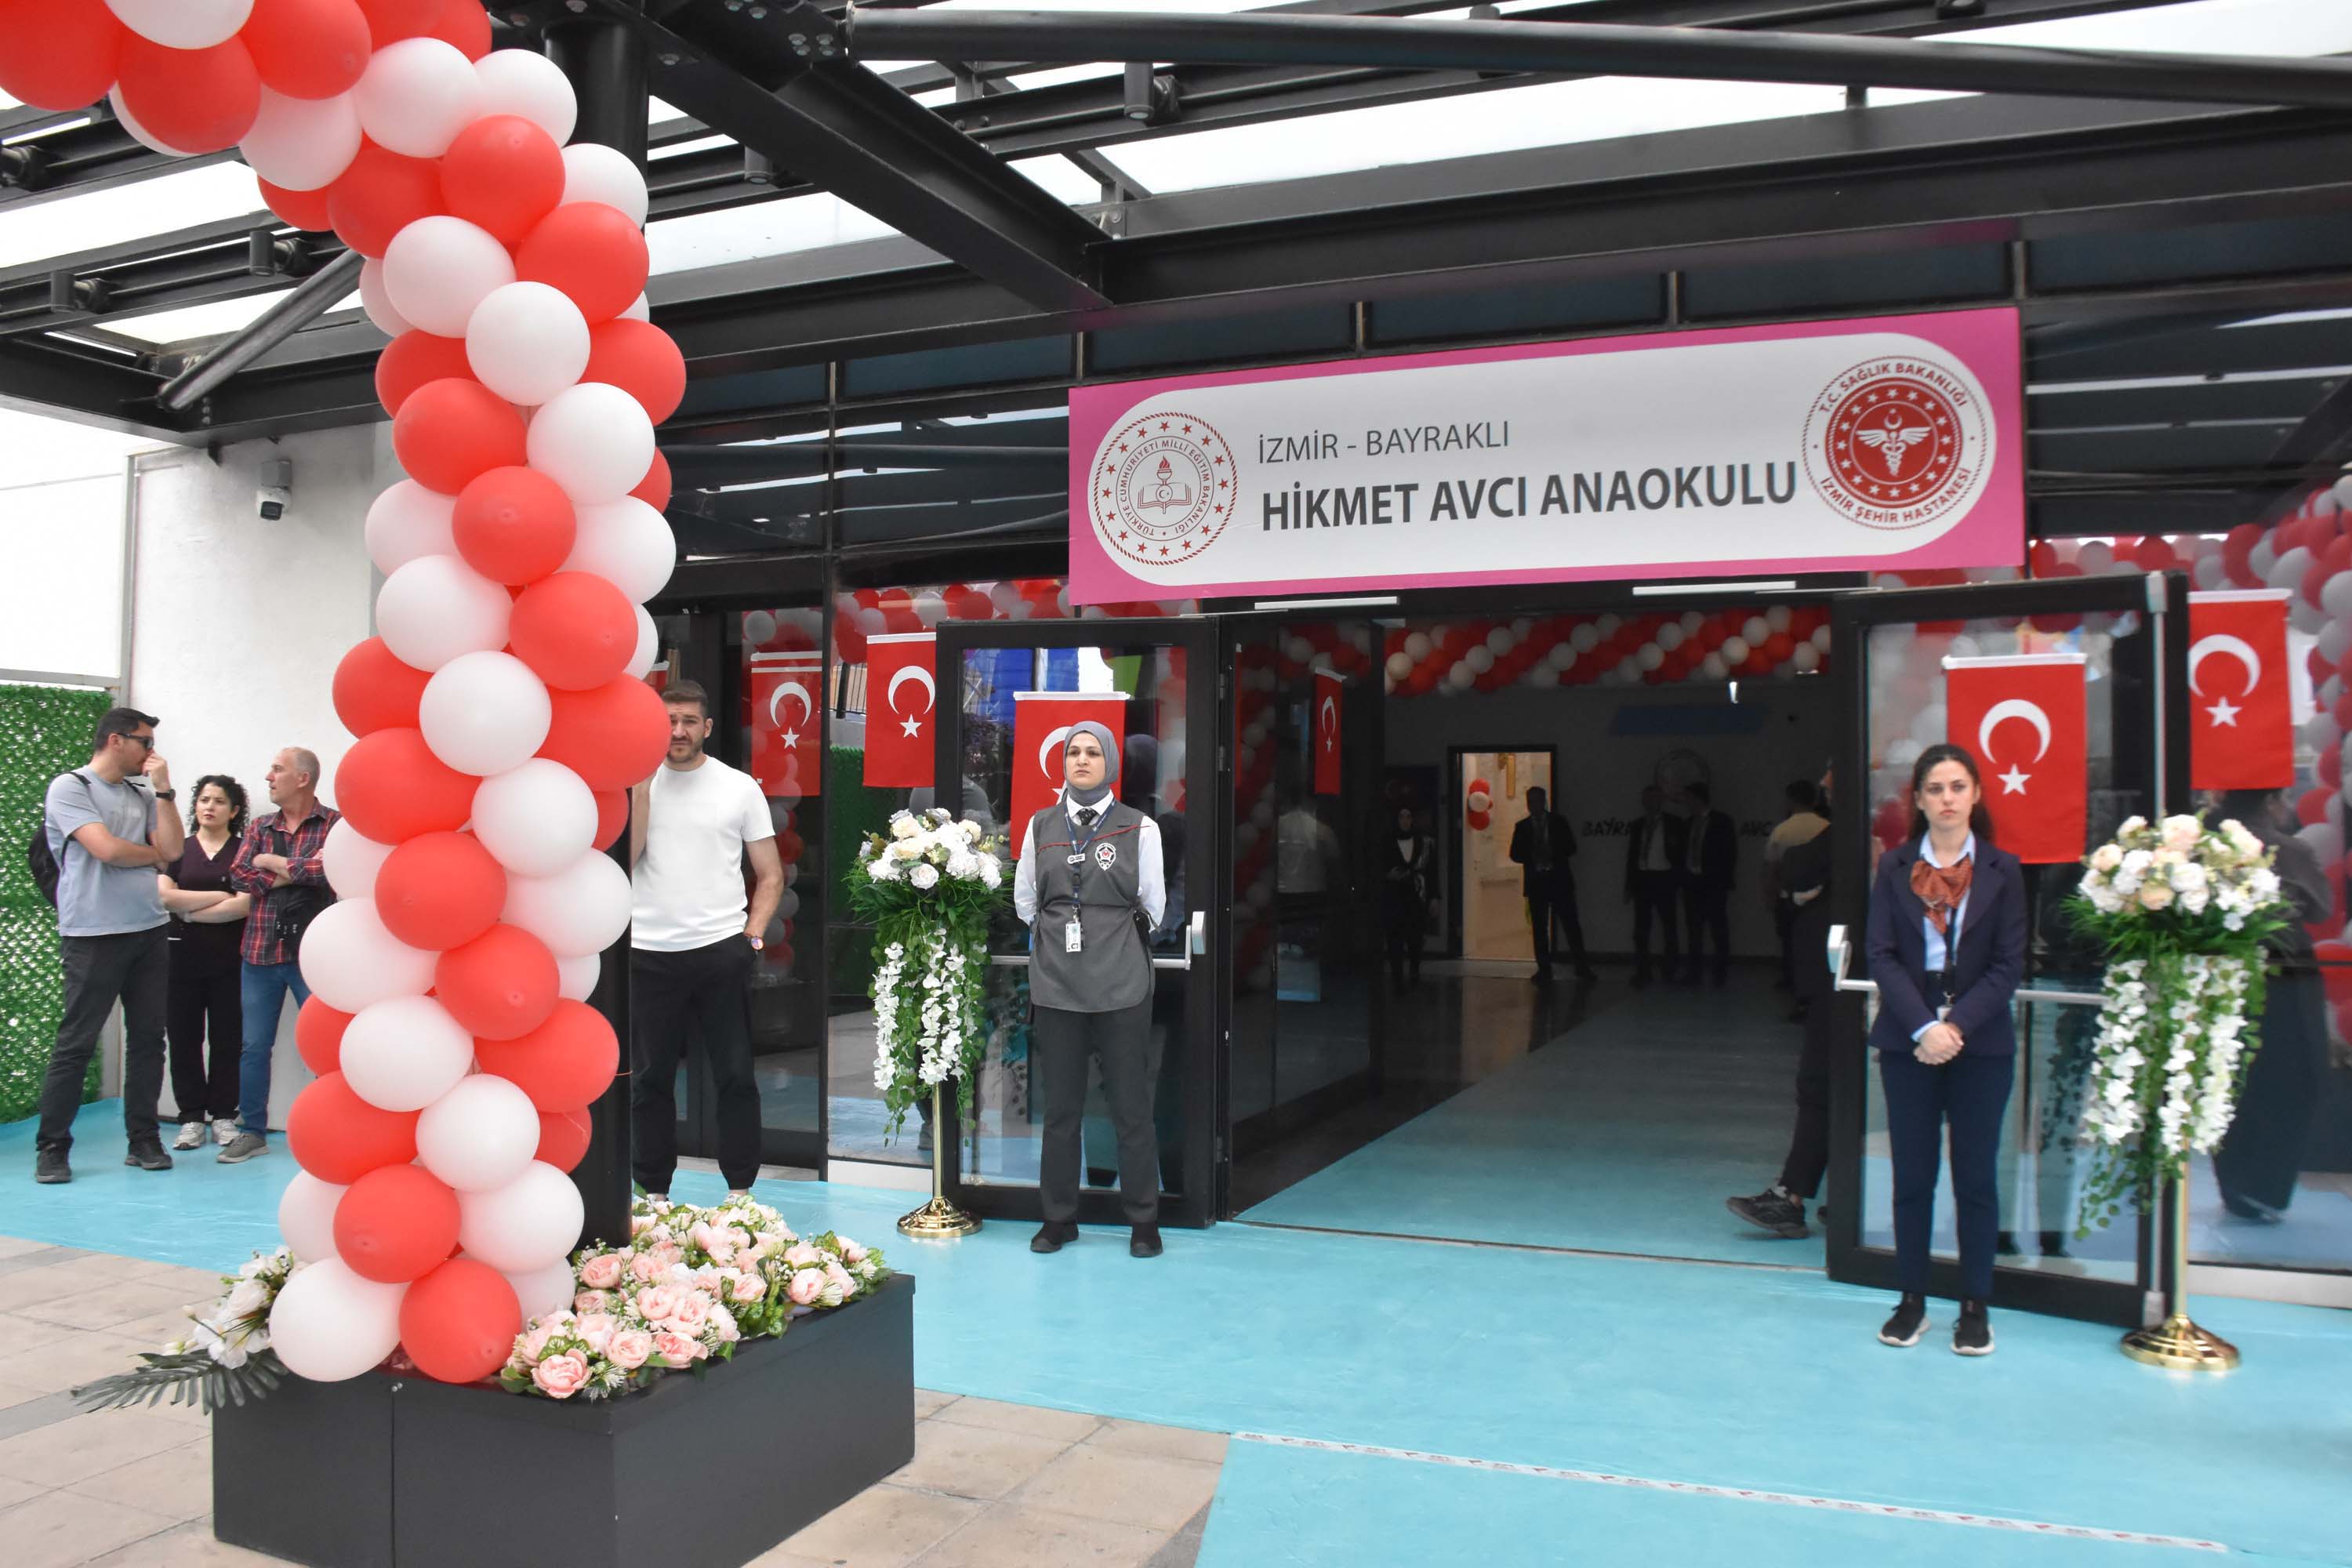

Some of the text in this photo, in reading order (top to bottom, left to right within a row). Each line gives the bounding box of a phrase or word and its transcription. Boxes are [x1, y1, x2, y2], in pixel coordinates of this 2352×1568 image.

[1819, 363, 1967, 412] T.C. SAĞLIK BAKANLIĞI
[1189, 450, 1210, 481] EĞİTİM
[1259, 430, 1338, 464] İZMİR
[1366, 420, 1509, 456] BAYRAKLI
[1120, 441, 1158, 502] CUMHURİYETİ
[1262, 460, 1796, 532] HİKMET AVCI ANAOKULU
[1820, 467, 1971, 523] İZMİR ŞEHİR HASTANESİ
[1123, 505, 1154, 535] TÜRKİYE
[1175, 485, 1210, 534] BAKANLIĞI
